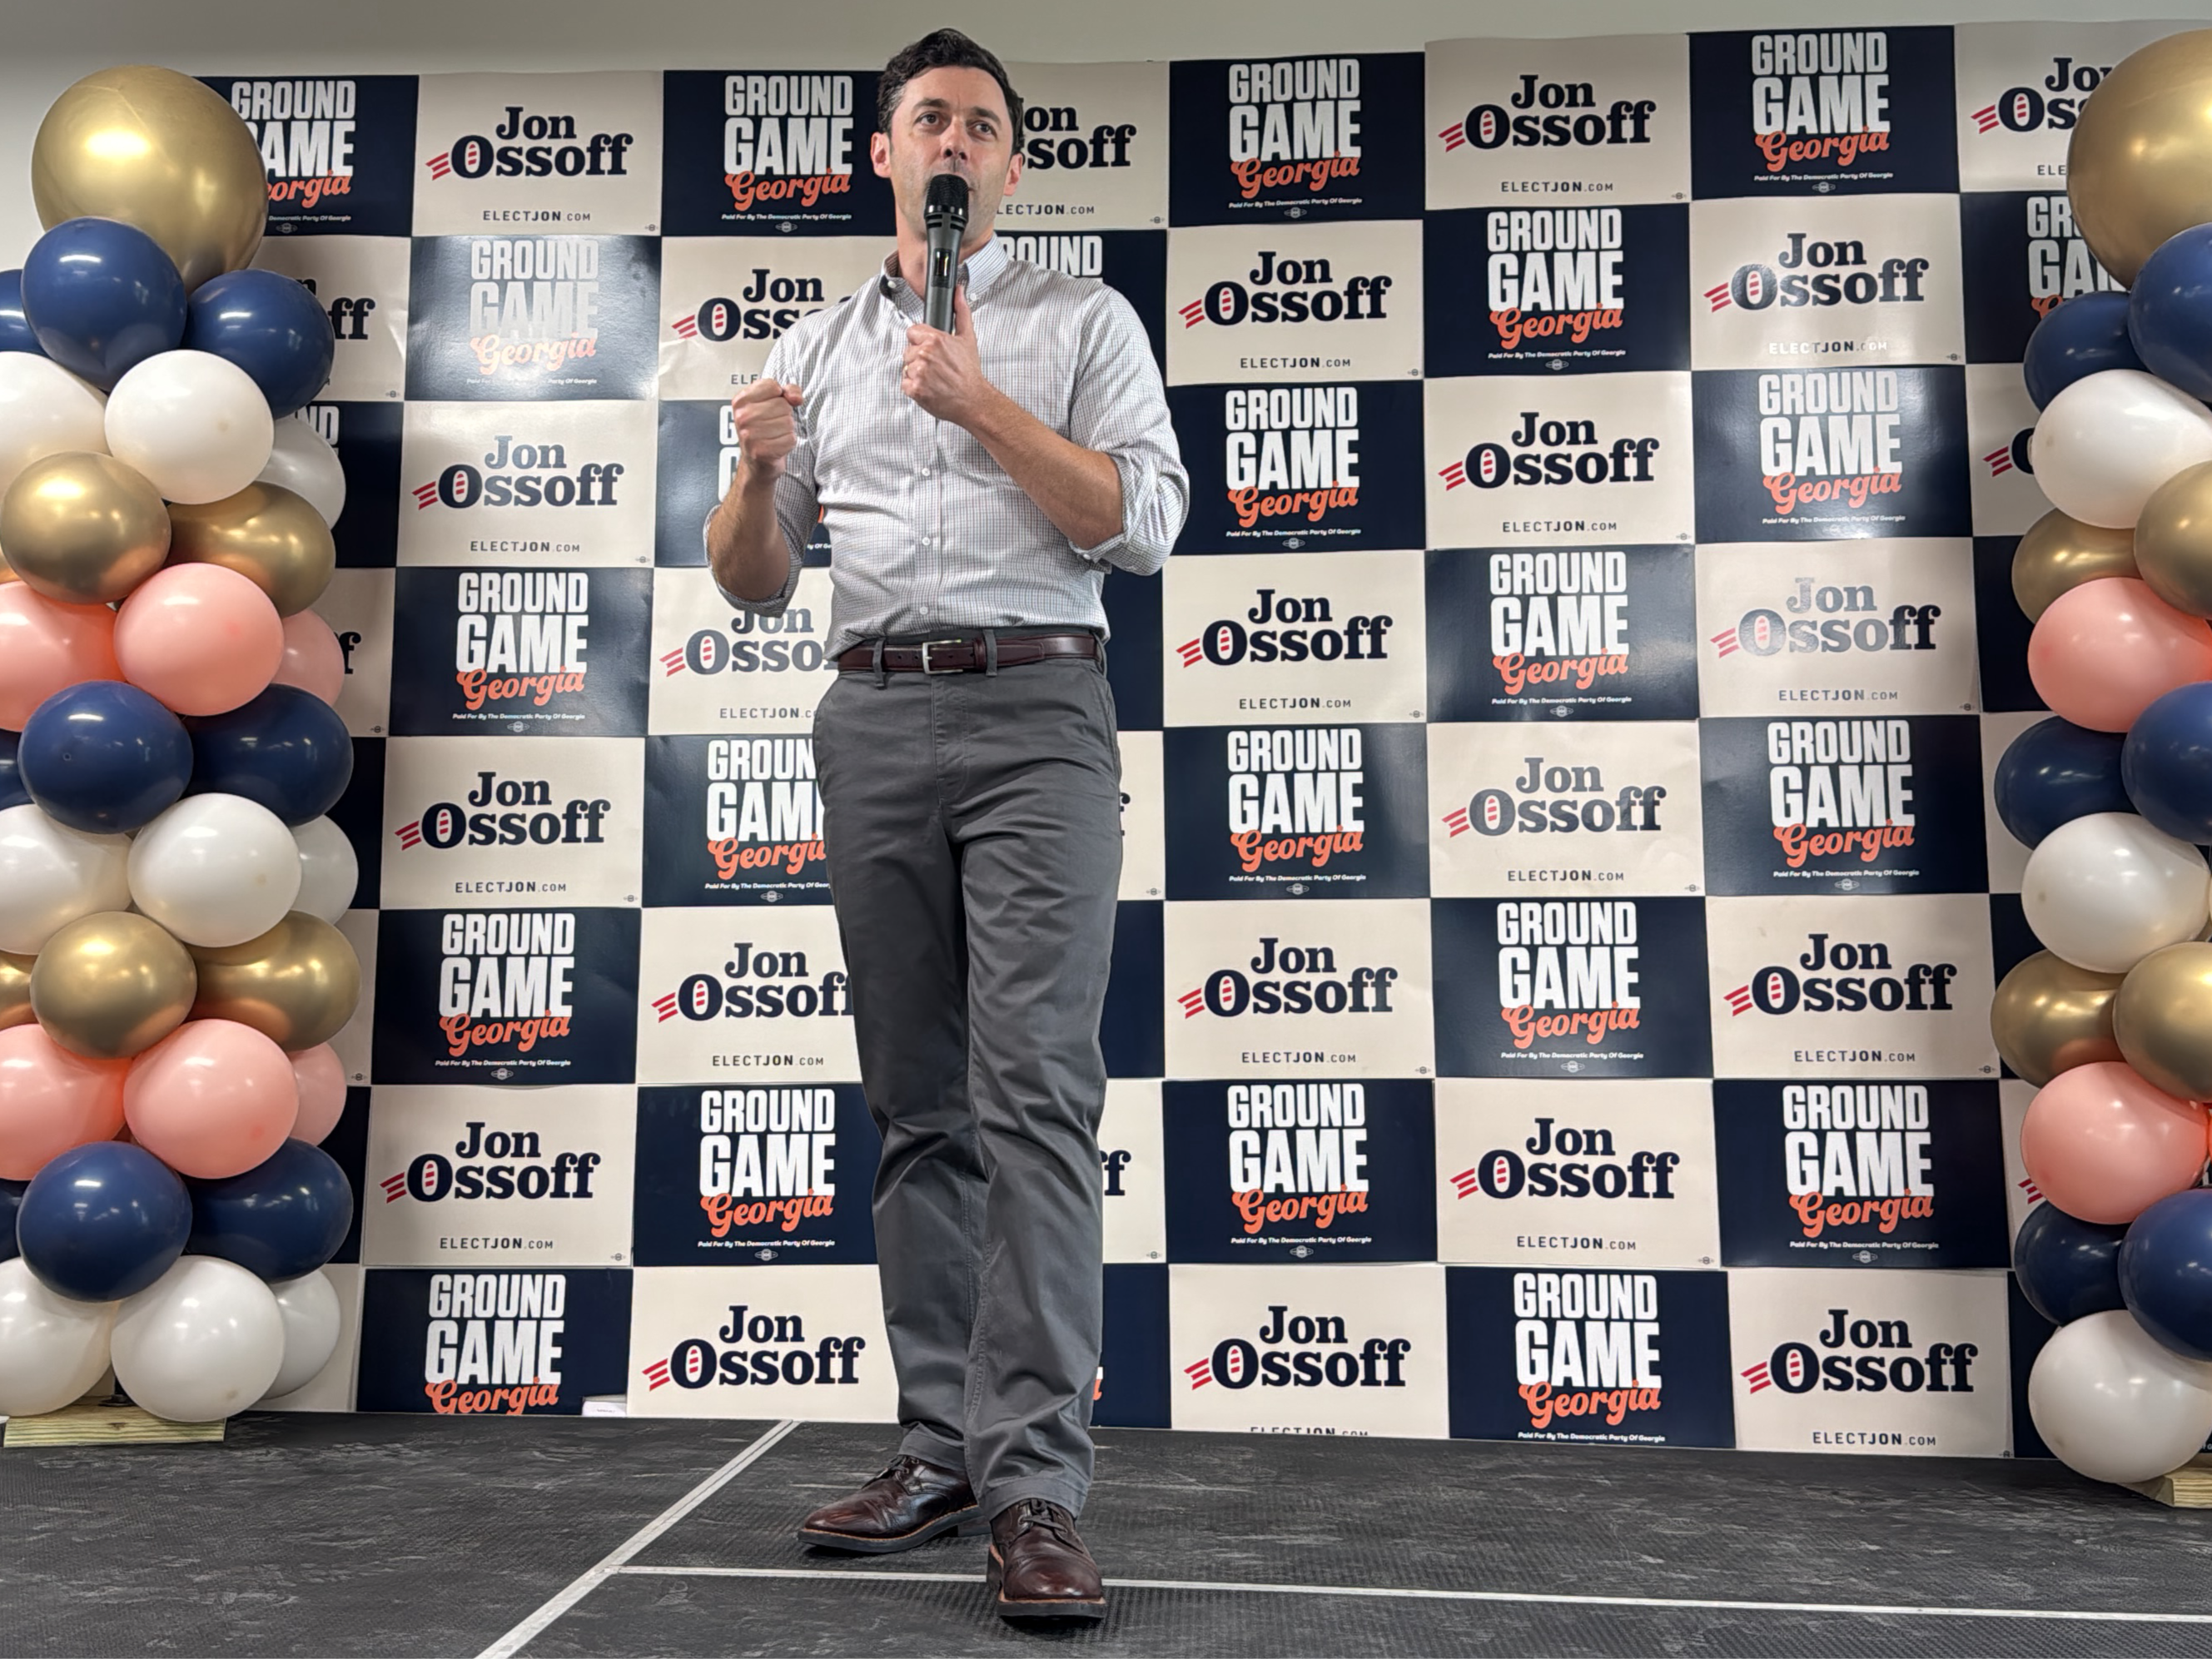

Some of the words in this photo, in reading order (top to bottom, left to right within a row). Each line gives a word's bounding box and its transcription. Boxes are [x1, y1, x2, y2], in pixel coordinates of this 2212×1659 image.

[1752, 32, 1886, 75] GROUND
[231, 81, 355, 119] GROUND
[725, 76, 852, 115] GROUND
[1230, 59, 1359, 103] GROUND
[1511, 75, 1595, 109] Jon
[496, 107, 576, 140] Jon
[1021, 98, 1079, 132] on
[1465, 101, 1656, 149] Ossoff
[1753, 74, 1890, 136] GAME
[245, 121, 355, 176] AME
[724, 117, 852, 176] GAME
[1022, 124, 1136, 169] soff
[1230, 100, 1360, 162] GAME
[1755, 126, 1888, 171] Georgia
[451, 133, 633, 178] Ossoff
[1230, 151, 1359, 198] Georgia
[267, 170, 350, 208] orgia
[724, 168, 849, 210] Georgia
[1488, 209, 1621, 251] GROUND
[1779, 233, 1867, 268] Jon
[471, 240, 599, 279] GROUND
[997, 236, 1102, 276] ROUND
[1250, 251, 1333, 286] Jon
[743, 269, 824, 302] Jon
[1205, 276, 1392, 325] Ossoff
[1489, 251, 1623, 312] GAME
[1732, 258, 1929, 310] Ossoff
[470, 281, 599, 340] GAME
[1489, 302, 1622, 350] Georgia
[470, 332, 596, 375] Georgia
[1226, 387, 1357, 430] GROUND
[1759, 370, 1899, 415] GROUND
[485, 435, 566, 469] Jon
[1512, 412, 1598, 447] Jon
[1760, 414, 1901, 477] GAME
[1226, 430, 1360, 491] GAME
[1465, 438, 1659, 489] Ossoff
[439, 464, 624, 509] Ossoff
[1227, 480, 1357, 527] Georgia
[1763, 467, 1900, 514] Georgia
[459, 573, 588, 613] GROUND
[1490, 552, 1627, 594] GROUND
[1786, 578, 1876, 613] Jon
[1248, 589, 1332, 623] Jon
[1491, 594, 1629, 658] GAME
[457, 614, 589, 673] GAME
[1203, 615, 1393, 665] Ossoff
[1737, 604, 1941, 656] Ossoff
[456, 666, 583, 709] Georgia
[1493, 648, 1627, 694] Georgia
[708, 738, 817, 780] GROUN
[1228, 729, 1361, 772] GROUND
[1767, 721, 1910, 764] GROUND
[469, 772, 551, 807] Jon
[1516, 757, 1603, 793] Jon
[1770, 765, 1914, 828] GAME
[421, 800, 610, 849] Ossoff
[1229, 772, 1364, 833] GAME
[1469, 786, 1667, 836] Ossoff
[1230, 825, 1362, 872] Georgia
[1773, 819, 1913, 867] Georgia
[443, 913, 575, 955] GROUND
[1498, 902, 1636, 944] GROUND
[724, 942, 808, 978] Jon
[1251, 938, 1336, 974] Jon
[1801, 934, 1891, 971] Jon
[440, 956, 574, 1019] GAME
[1205, 967, 1398, 1017] Ossoff
[1499, 946, 1640, 1010] GAME
[1752, 963, 1957, 1015] Ossoff
[440, 1009, 569, 1056] Georgia
[1501, 1001, 1639, 1048] Georgia
[701, 1089, 834, 1132] GROUND
[1228, 1084, 1364, 1128] GROUND
[1783, 1085, 1928, 1129] GROUND
[455, 1122, 540, 1159] Jon
[1526, 1118, 1615, 1155] Jon
[407, 1153, 600, 1202] Ossoff
[700, 1134, 835, 1198] GAME
[1230, 1129, 1369, 1193] GAME
[1478, 1150, 1679, 1199] Ossoff
[1785, 1131, 1933, 1196] GAME
[700, 1187, 833, 1234] Georgia
[1231, 1184, 1367, 1232] Georgia
[1789, 1189, 1932, 1237] Georgia
[430, 1274, 565, 1318] GROUND
[1514, 1274, 1657, 1319] GROUND
[719, 1306, 804, 1344] Jon
[1260, 1306, 1348, 1344] Jon
[1820, 1309, 1912, 1348] Jon
[425, 1320, 564, 1387] GAME
[671, 1337, 865, 1388] Ossoff
[1212, 1339, 1410, 1388] Ossoff
[1516, 1320, 1661, 1389] GAME
[1771, 1343, 1978, 1393] Ossoff
[425, 1377, 558, 1415] Georgia
[1519, 1378, 1660, 1428] Georgia
